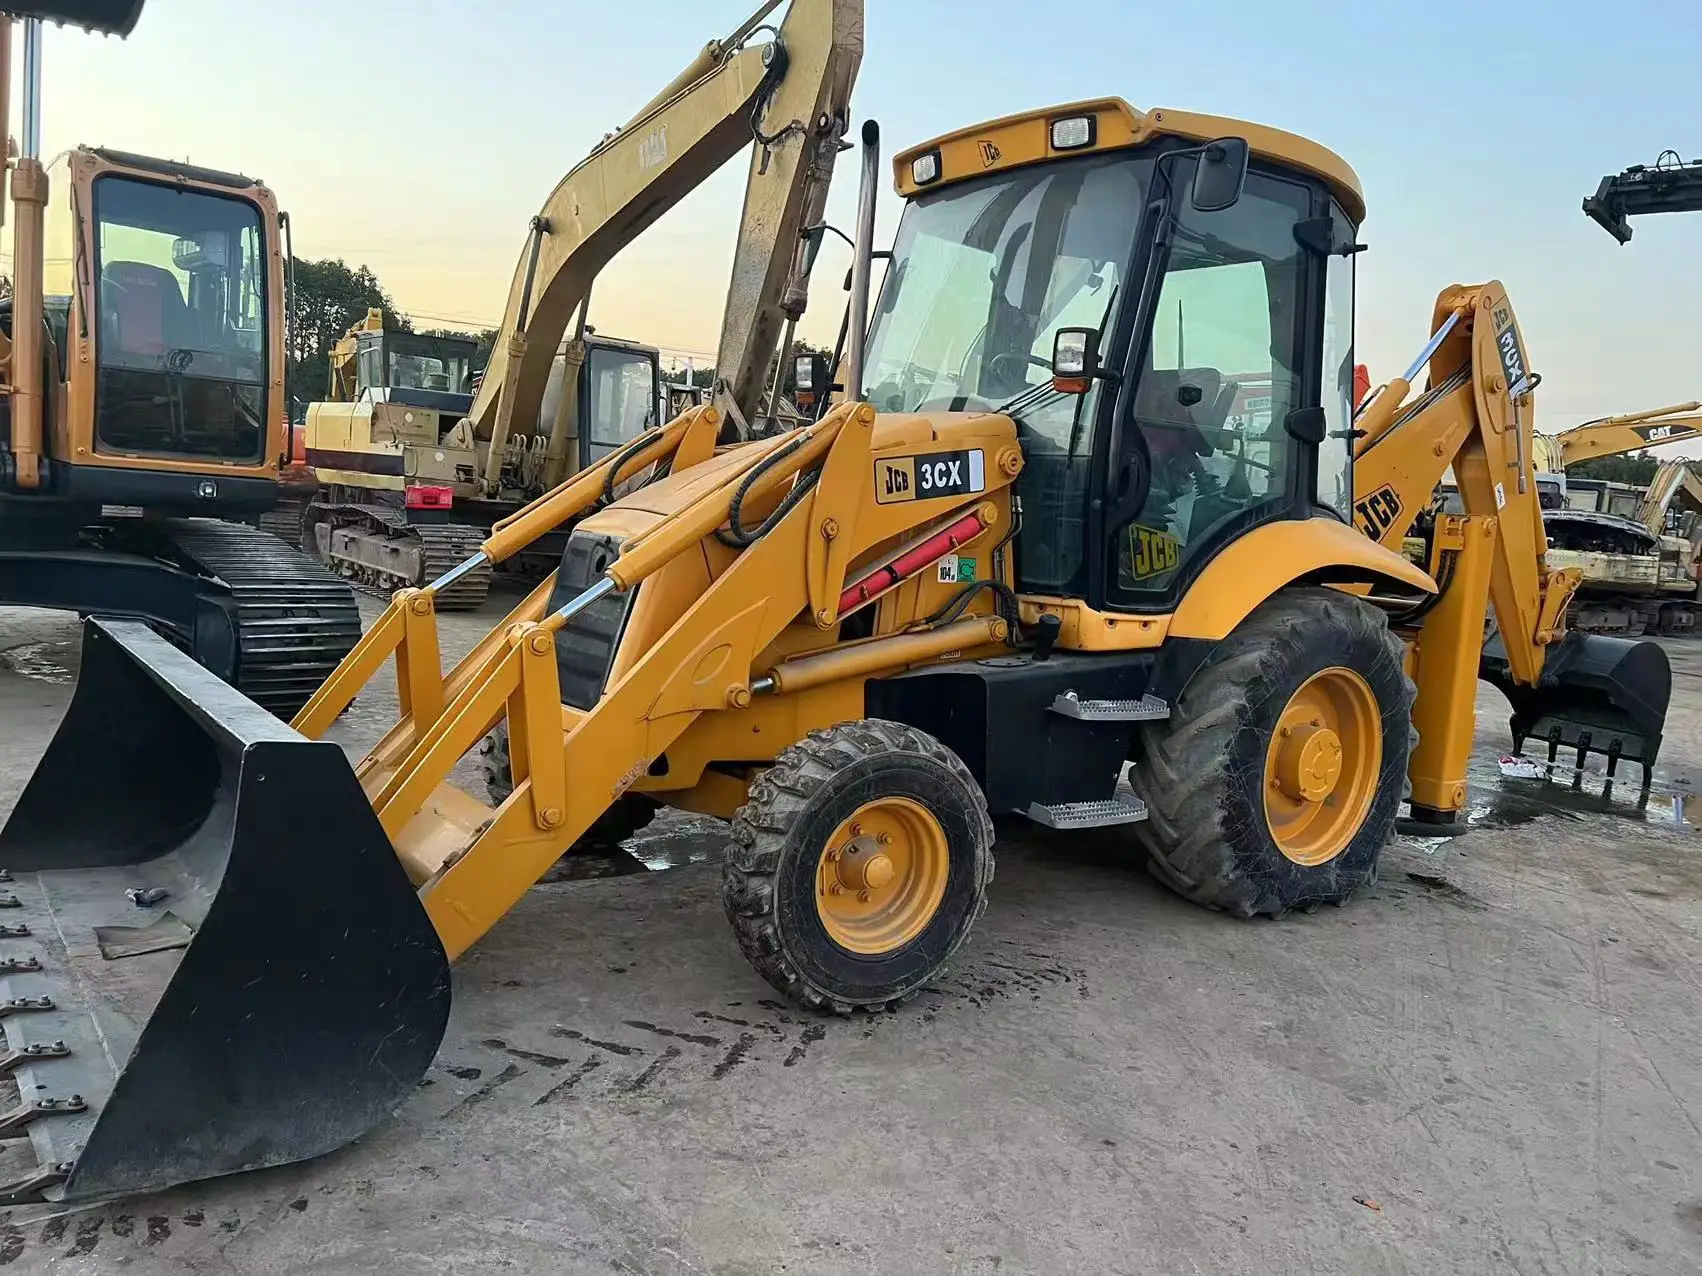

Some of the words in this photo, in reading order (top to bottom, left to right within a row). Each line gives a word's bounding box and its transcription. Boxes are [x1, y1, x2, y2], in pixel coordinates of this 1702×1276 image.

[982, 143, 1000, 161] JCB
[1493, 308, 1509, 331] JCB
[1500, 332, 1523, 382] 3CX
[1649, 425, 1672, 441] CAT
[885, 465, 909, 495] JCB
[921, 460, 962, 490] 3CX
[1355, 488, 1400, 542] JCB
[1135, 529, 1176, 574] JCB
